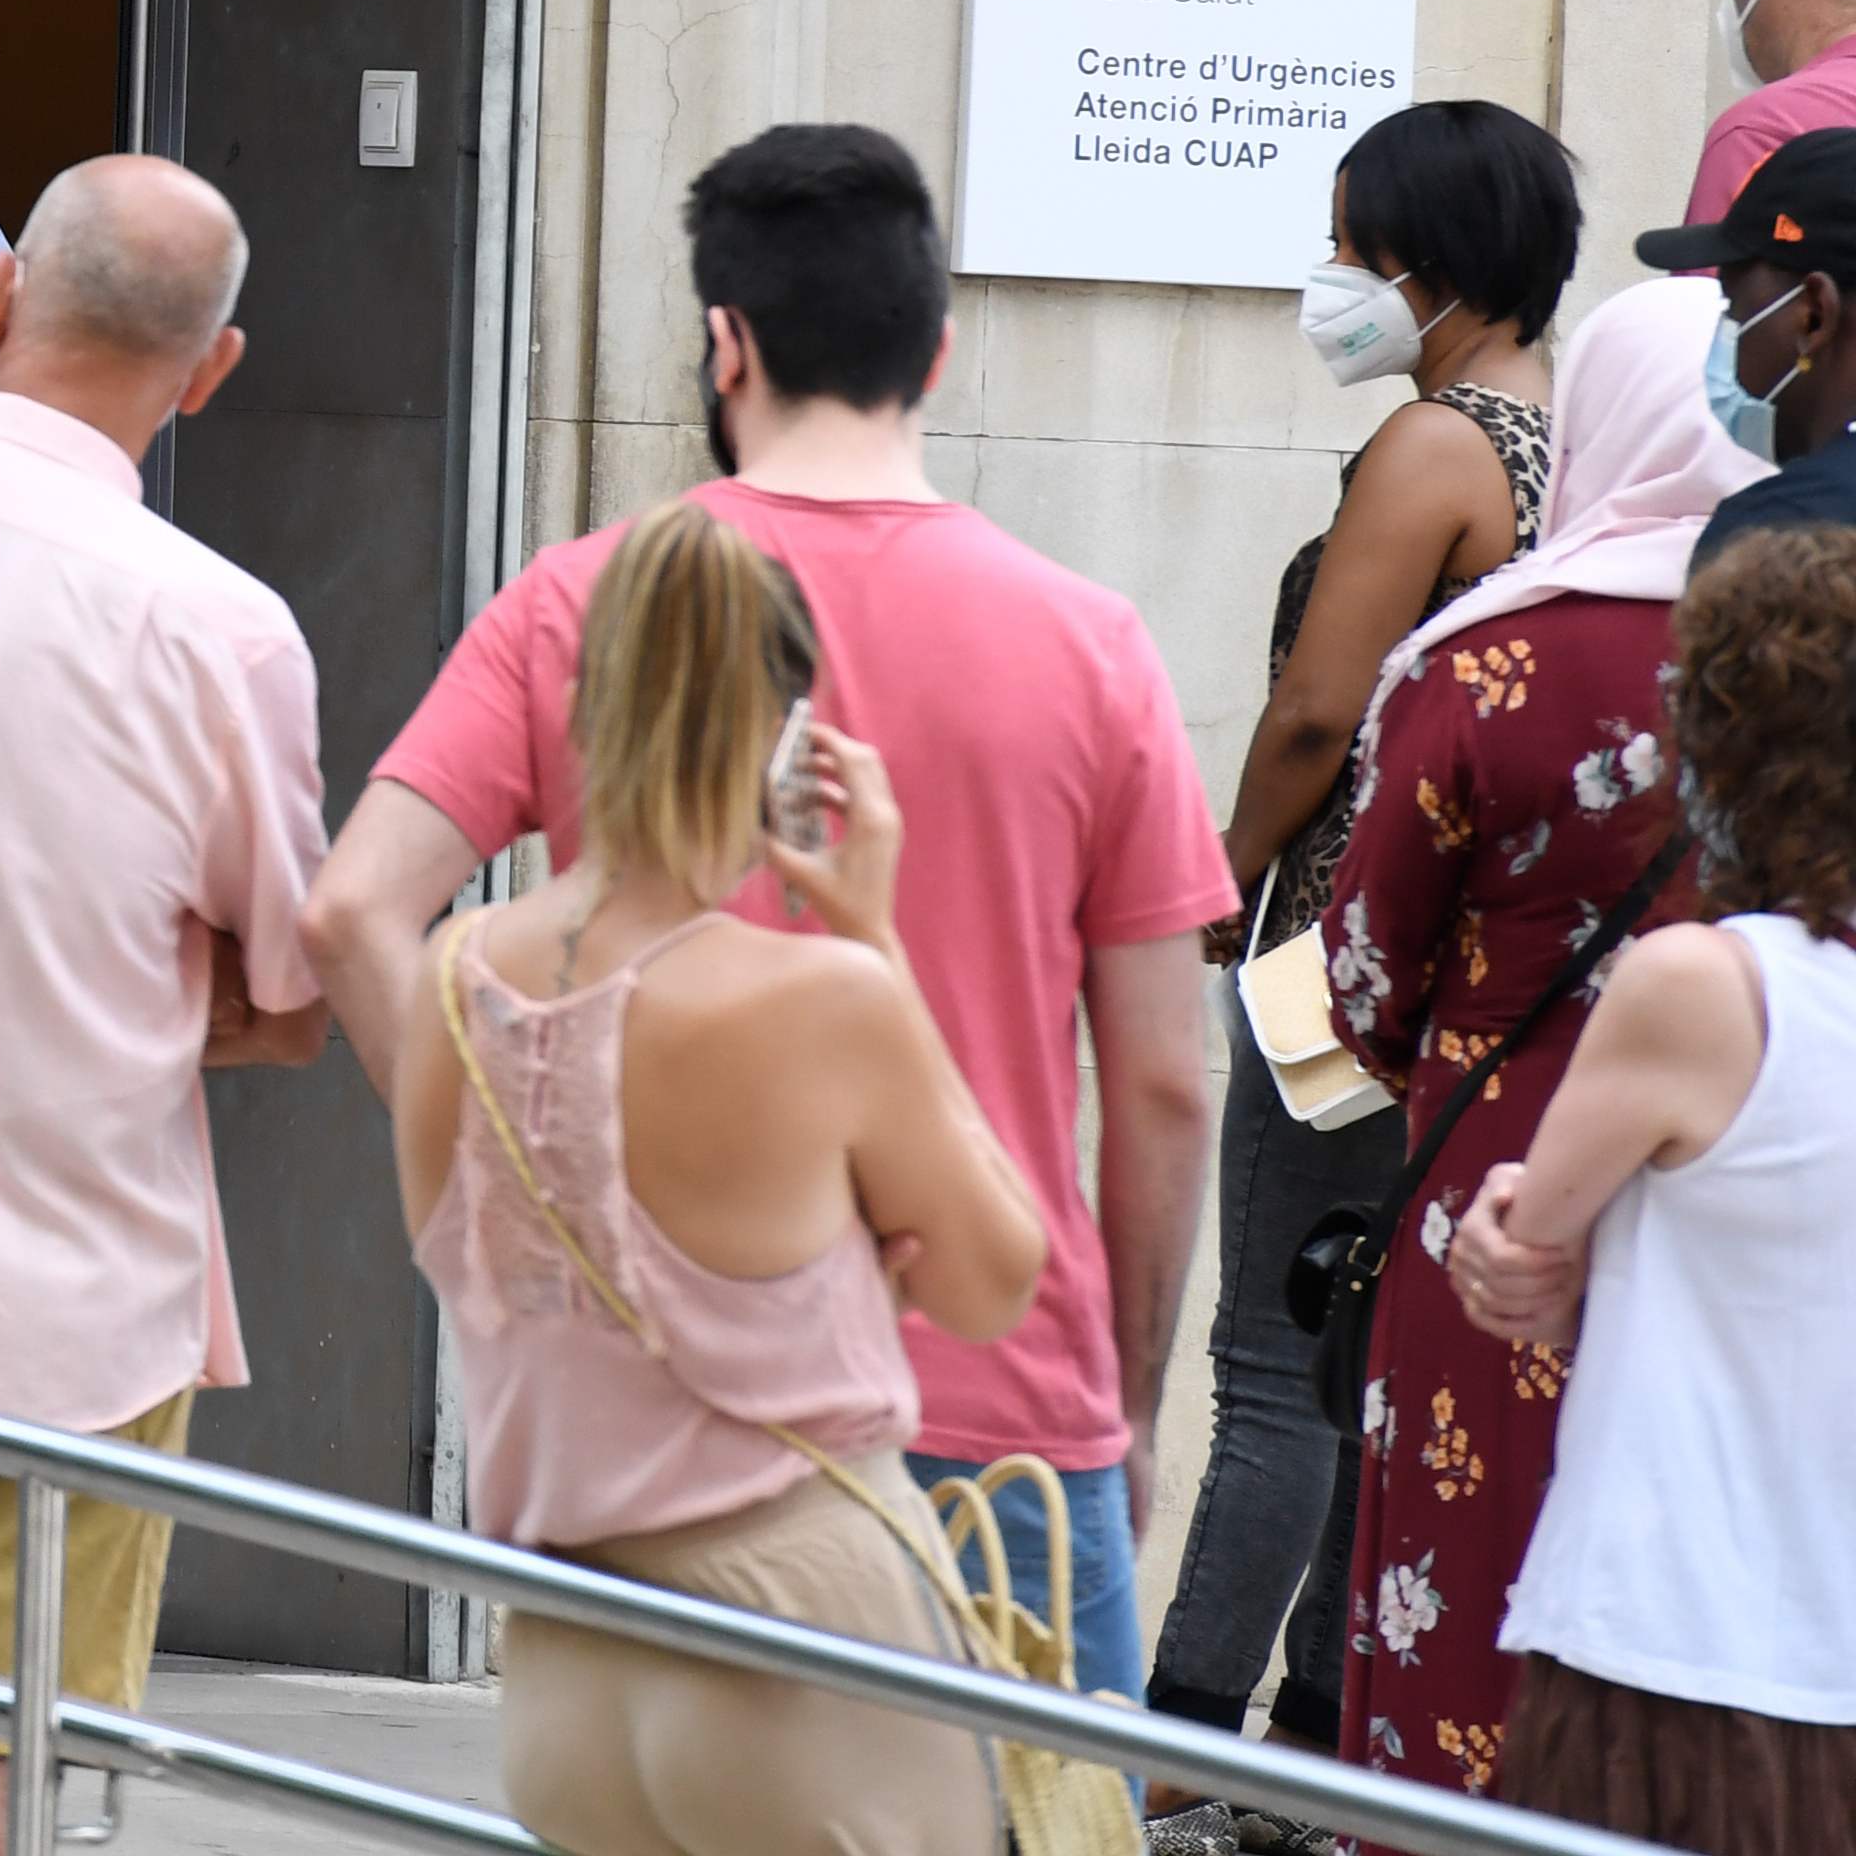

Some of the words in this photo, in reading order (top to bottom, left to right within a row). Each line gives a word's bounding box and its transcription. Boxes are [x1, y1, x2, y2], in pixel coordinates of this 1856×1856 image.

[1077, 48, 1187, 80] Centre
[1199, 54, 1397, 91] d'Urgències
[1074, 91, 1198, 124] Atenció
[1210, 97, 1348, 131] Primària
[1074, 134, 1172, 165] Lleida
[1184, 138, 1279, 170] CUAP
